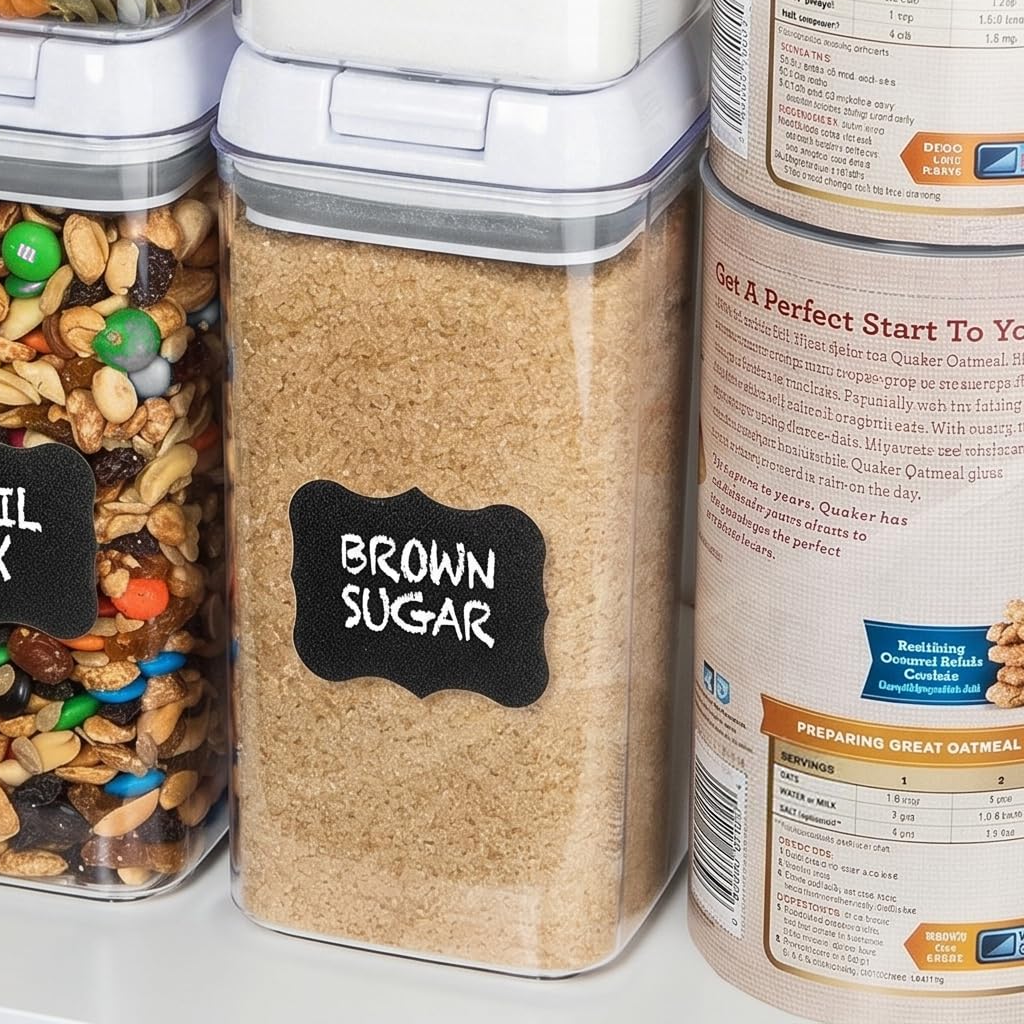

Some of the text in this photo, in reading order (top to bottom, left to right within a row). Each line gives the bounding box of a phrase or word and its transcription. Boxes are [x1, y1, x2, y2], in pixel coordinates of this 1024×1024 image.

[716, 262, 740, 296] Get
[744, 280, 759, 306] A
[764, 288, 854, 332] Perfect
[862, 313, 938, 341] Start
[946, 320, 984, 342] To
[891, 351, 943, 367] Quaker
[851, 457, 901, 476] Quaker
[868, 481, 890, 498] the
[893, 484, 921, 504] day.
[819, 501, 877, 524] Quaker
[880, 511, 908, 527] has
[772, 528, 842, 559] the perfect
[852, 529, 867, 542] to
[341, 533, 495, 590] BROWN
[342, 583, 494, 648] SUGAR
[798, 721, 1022, 755] PREPARING GREAT OATMEAL
[780, 751, 1005, 786] SERVINGS 1 2
